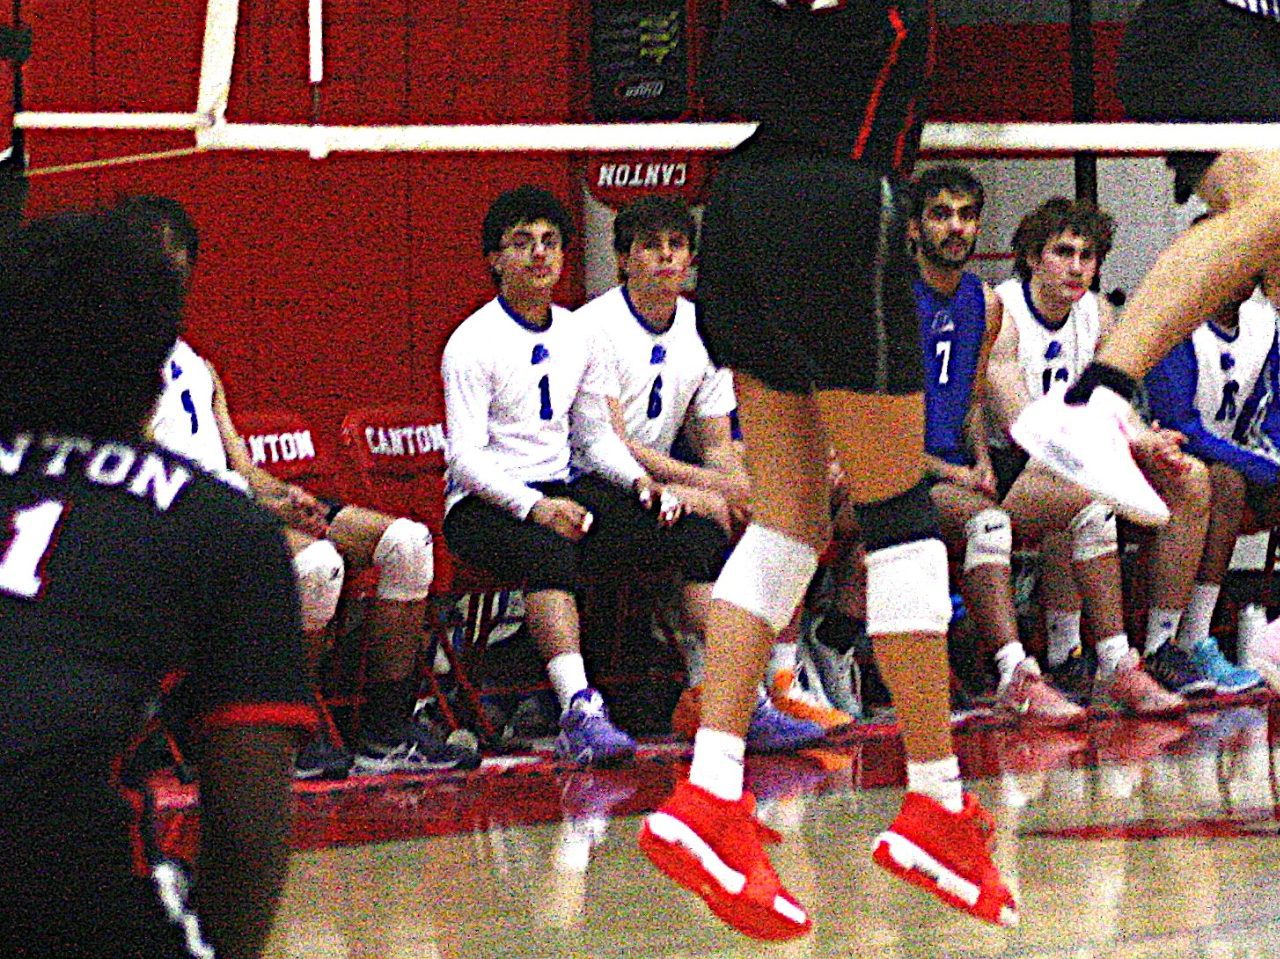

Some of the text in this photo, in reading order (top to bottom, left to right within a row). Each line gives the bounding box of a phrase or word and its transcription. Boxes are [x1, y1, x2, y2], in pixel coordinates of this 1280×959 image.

[597, 163, 687, 187] CANTON
[935, 340, 952, 385] 7
[538, 374, 554, 421] 1
[365, 422, 448, 456] CANTON
